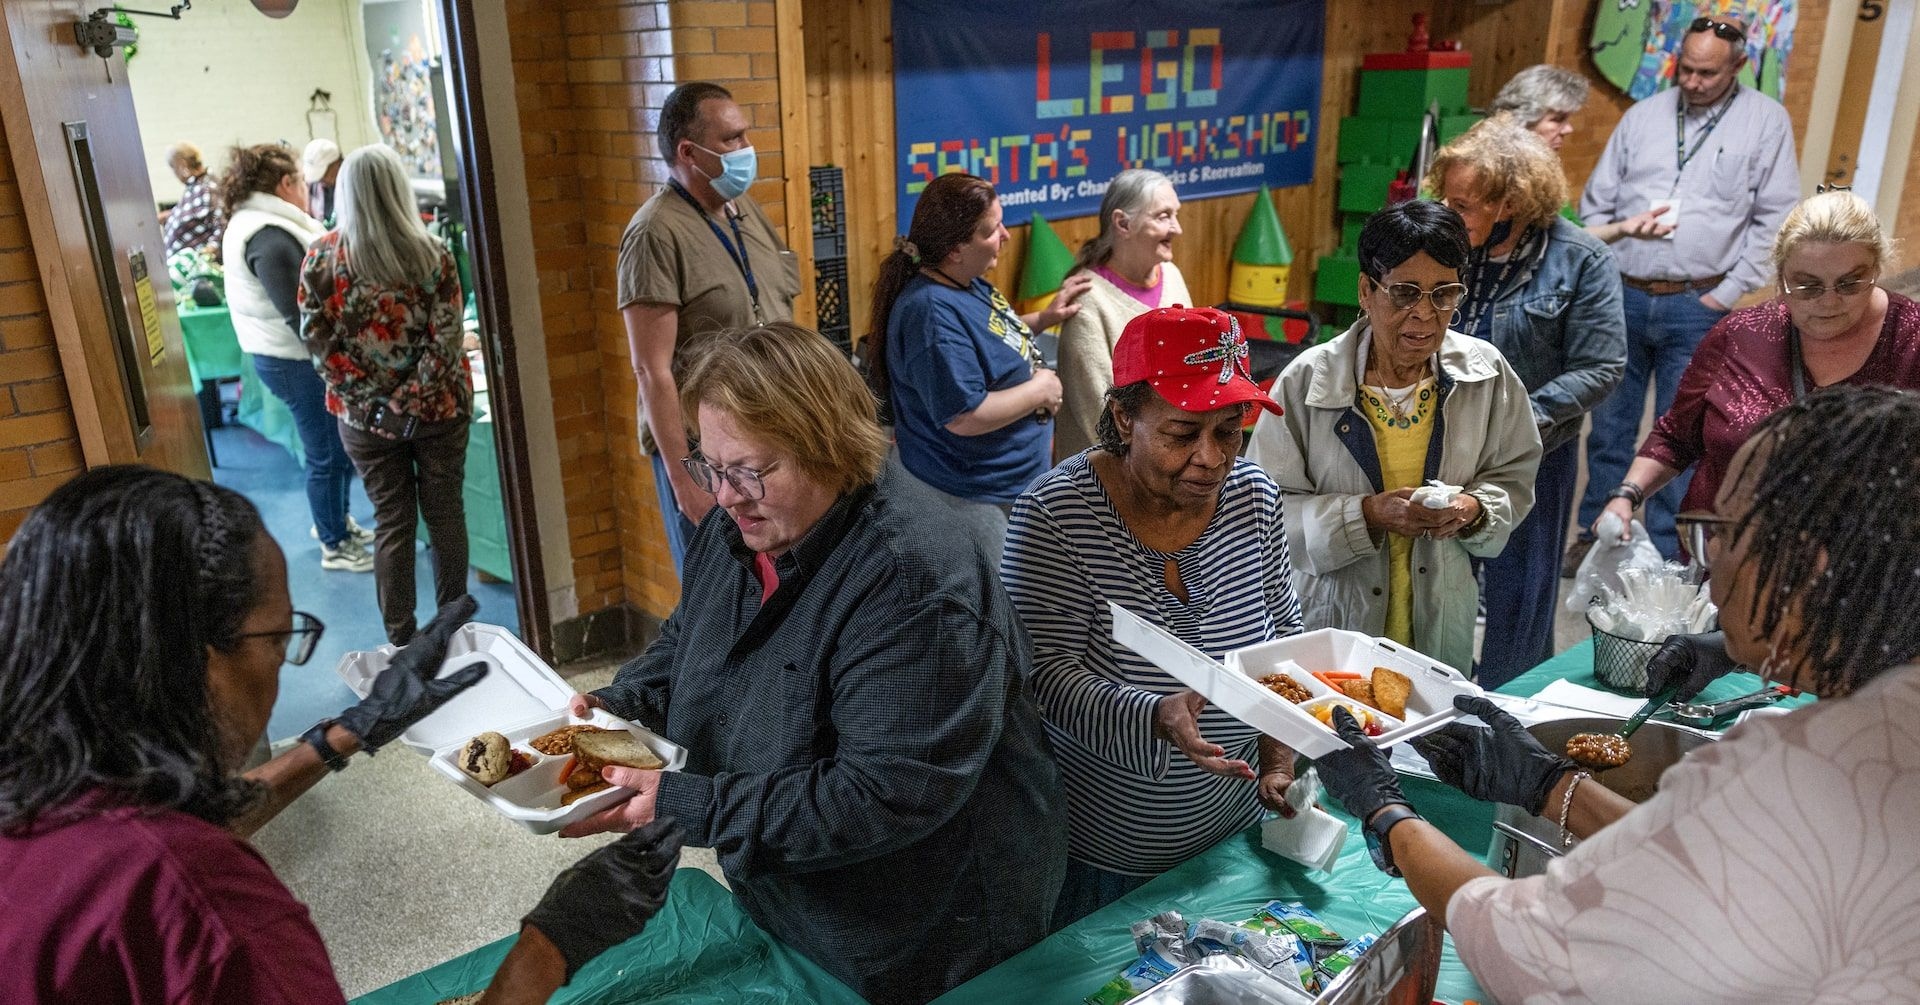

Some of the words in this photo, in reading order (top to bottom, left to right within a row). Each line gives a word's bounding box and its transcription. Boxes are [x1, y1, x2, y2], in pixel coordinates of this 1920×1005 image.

[1858, 0, 1882, 22] 5
[1036, 28, 1224, 119] LEGO
[906, 123, 1092, 194] SANTA'S
[1118, 110, 1310, 169] WORKSHOP
[1050, 183, 1075, 202] By:
[1188, 167, 1200, 183] &
[1201, 161, 1265, 182] Recreation
